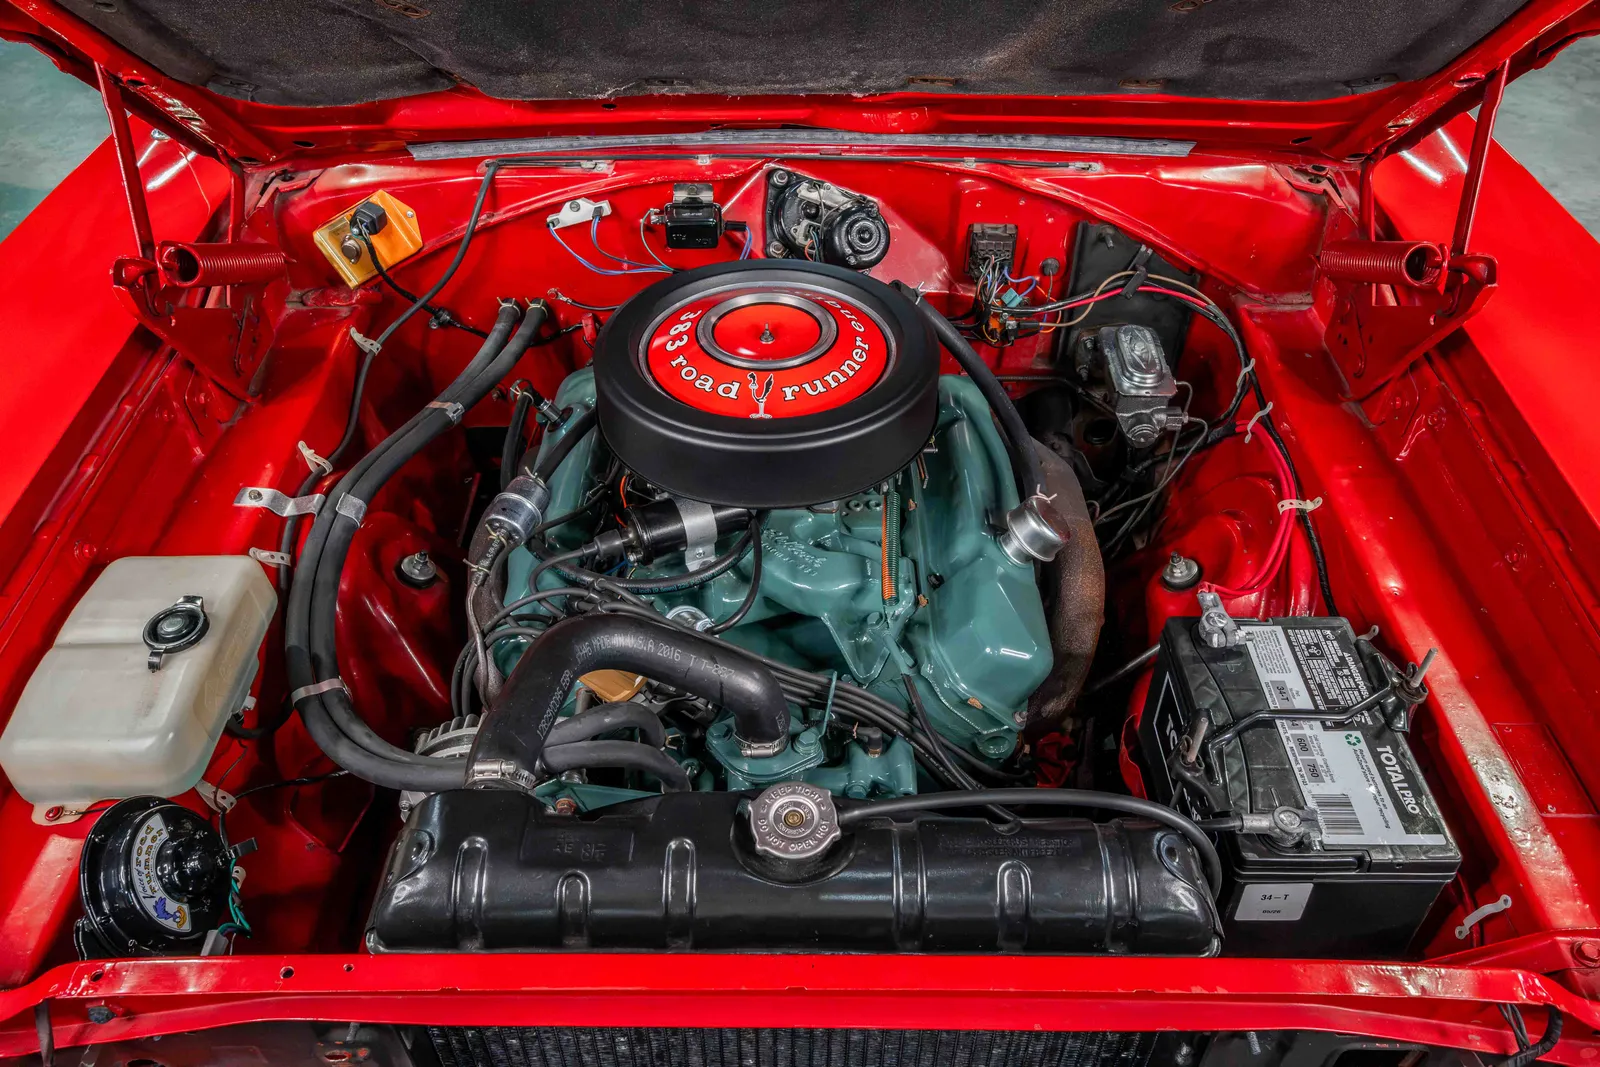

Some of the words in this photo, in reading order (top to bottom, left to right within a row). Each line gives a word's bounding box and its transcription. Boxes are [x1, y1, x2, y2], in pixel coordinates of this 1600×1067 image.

[665, 308, 702, 352] 383
[670, 354, 741, 401] road
[781, 336, 870, 402] runner
[657, 643, 682, 662] 2016
[1344, 656, 1370, 699] DANGER/POIS
[1275, 686, 1289, 701] 34-T
[1295, 737, 1309, 751] 600
[1306, 763, 1319, 777] 750
[765, 785, 792, 803] KEEP
[795, 785, 824, 804] TIGHT
[136, 825, 154, 867] road
[757, 817, 769, 833] DO
[765, 833, 787, 849] NOT
[788, 837, 819, 852] OPEN
[815, 818, 830, 839] HOT
[134, 867, 144, 877] of
[144, 828, 163, 895] runner
[139, 877, 156, 899] Voice
